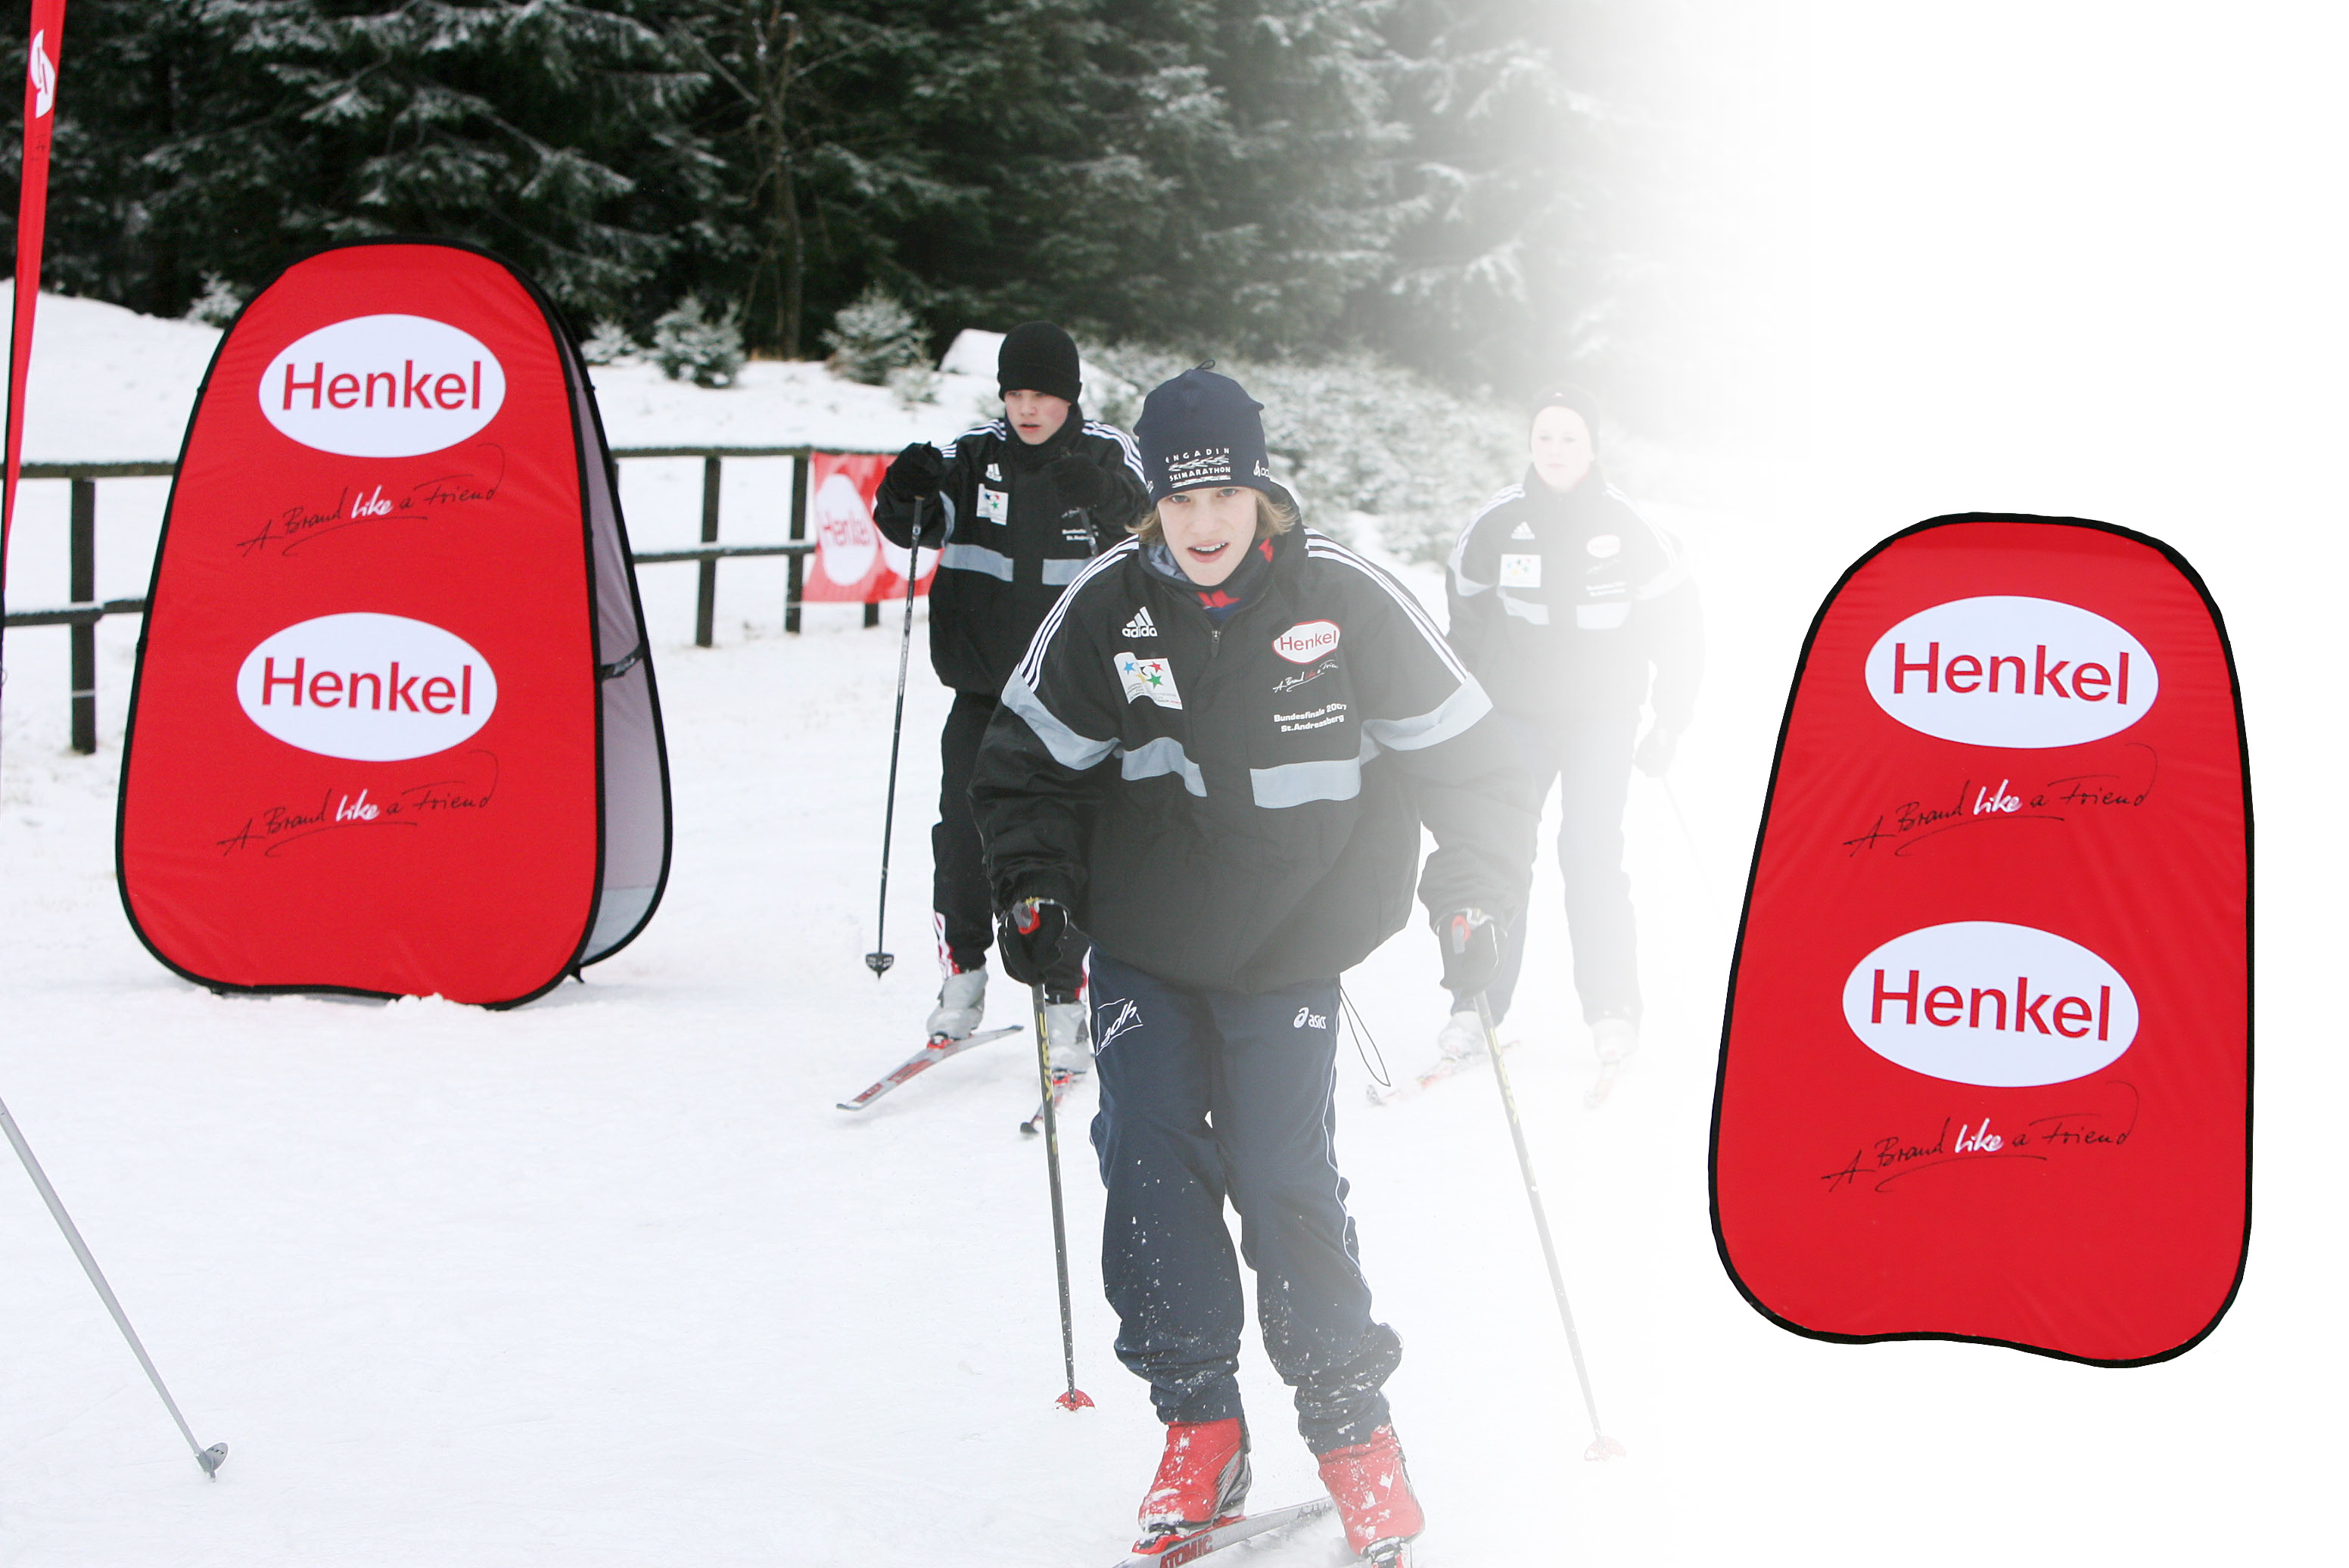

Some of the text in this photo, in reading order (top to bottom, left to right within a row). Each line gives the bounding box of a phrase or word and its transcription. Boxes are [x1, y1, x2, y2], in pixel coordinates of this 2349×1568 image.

[282, 359, 482, 410] Henkel
[1169, 466, 1231, 482] SKIMARATHON
[236, 519, 284, 558] A
[283, 487, 349, 534] Brand
[399, 498, 415, 510] a
[1122, 625, 1158, 638] adida
[1280, 630, 1337, 651] Henkel
[262, 657, 471, 715] Henkel
[1893, 642, 2130, 705] Henkel
[1274, 703, 1347, 722] Bundesfinale 2007
[216, 819, 265, 856] A
[263, 789, 332, 834] Brand
[386, 801, 402, 814] a
[1843, 816, 1896, 857] A
[1896, 779, 1971, 832] Brand
[2030, 793, 2049, 807] a
[1871, 969, 2111, 1041] Henkel
[1821, 1150, 1876, 1193] A
[1875, 1117, 1950, 1168] Brand
[2012, 1134, 2031, 1147] a
